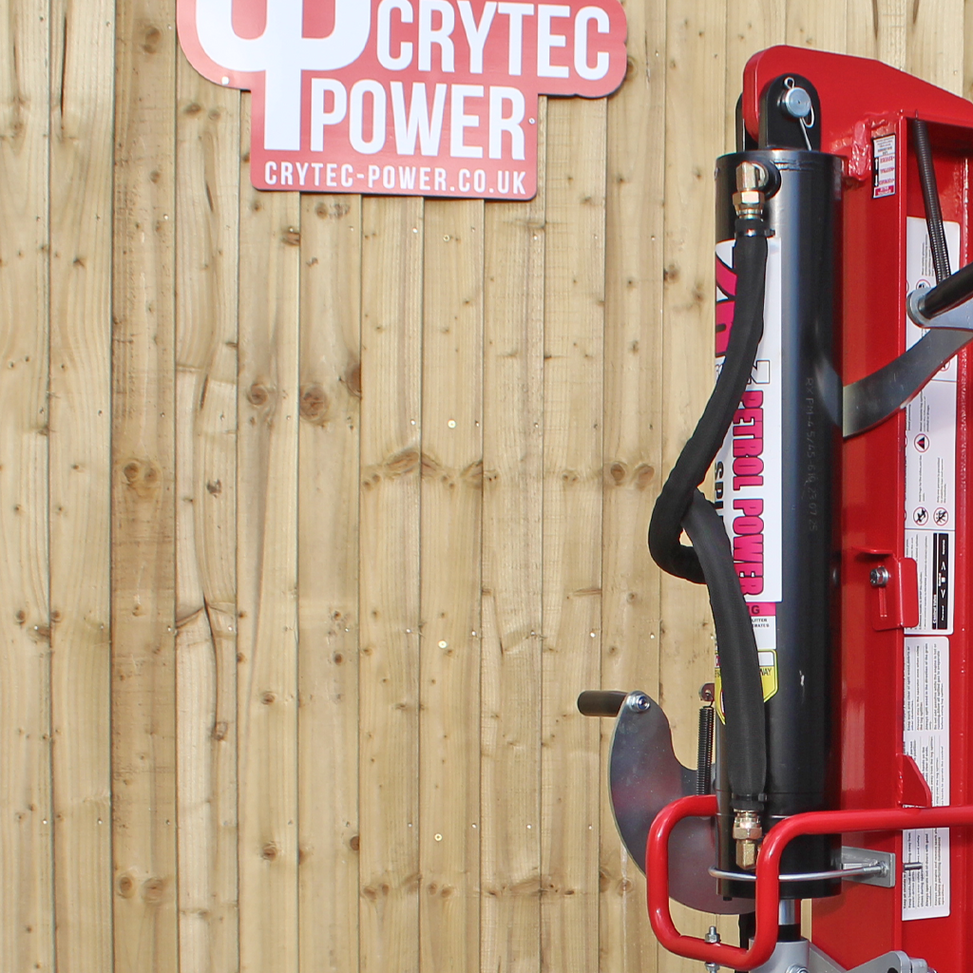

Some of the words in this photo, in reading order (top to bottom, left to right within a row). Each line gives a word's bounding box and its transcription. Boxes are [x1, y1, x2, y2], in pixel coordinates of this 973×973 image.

[375, 0, 611, 81] CRYTEC
[310, 77, 526, 161] POWER
[264, 160, 527, 195] CRYTEC-POWER.CO.UK
[733, 391, 764, 491] PETROL
[733, 499, 764, 597] POWER
